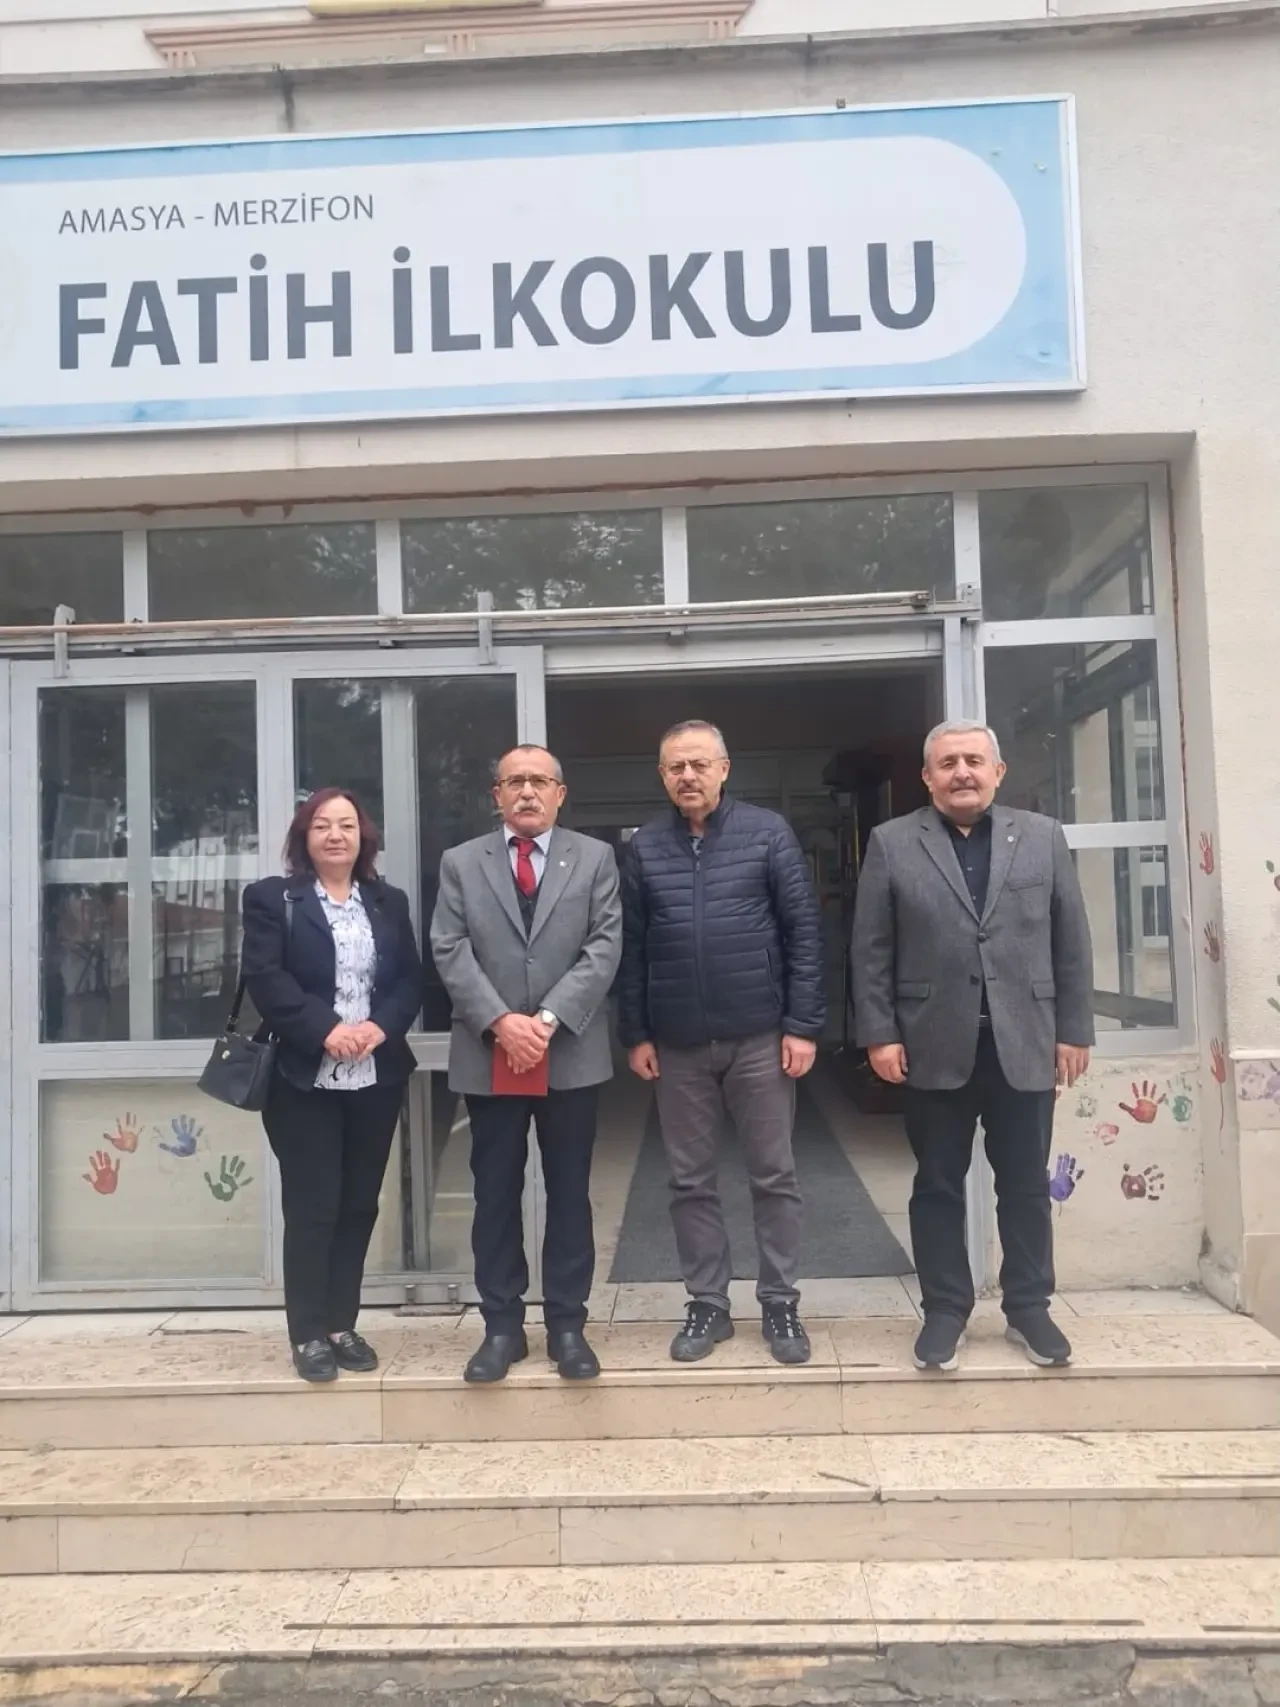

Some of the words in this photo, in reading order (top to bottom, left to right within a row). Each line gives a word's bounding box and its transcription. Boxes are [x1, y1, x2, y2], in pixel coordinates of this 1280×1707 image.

[58, 204, 186, 235] AMASYA
[213, 192, 375, 228] MERZİFON
[59, 253, 352, 370] FATİH
[393, 240, 936, 354] İLKOKULU
